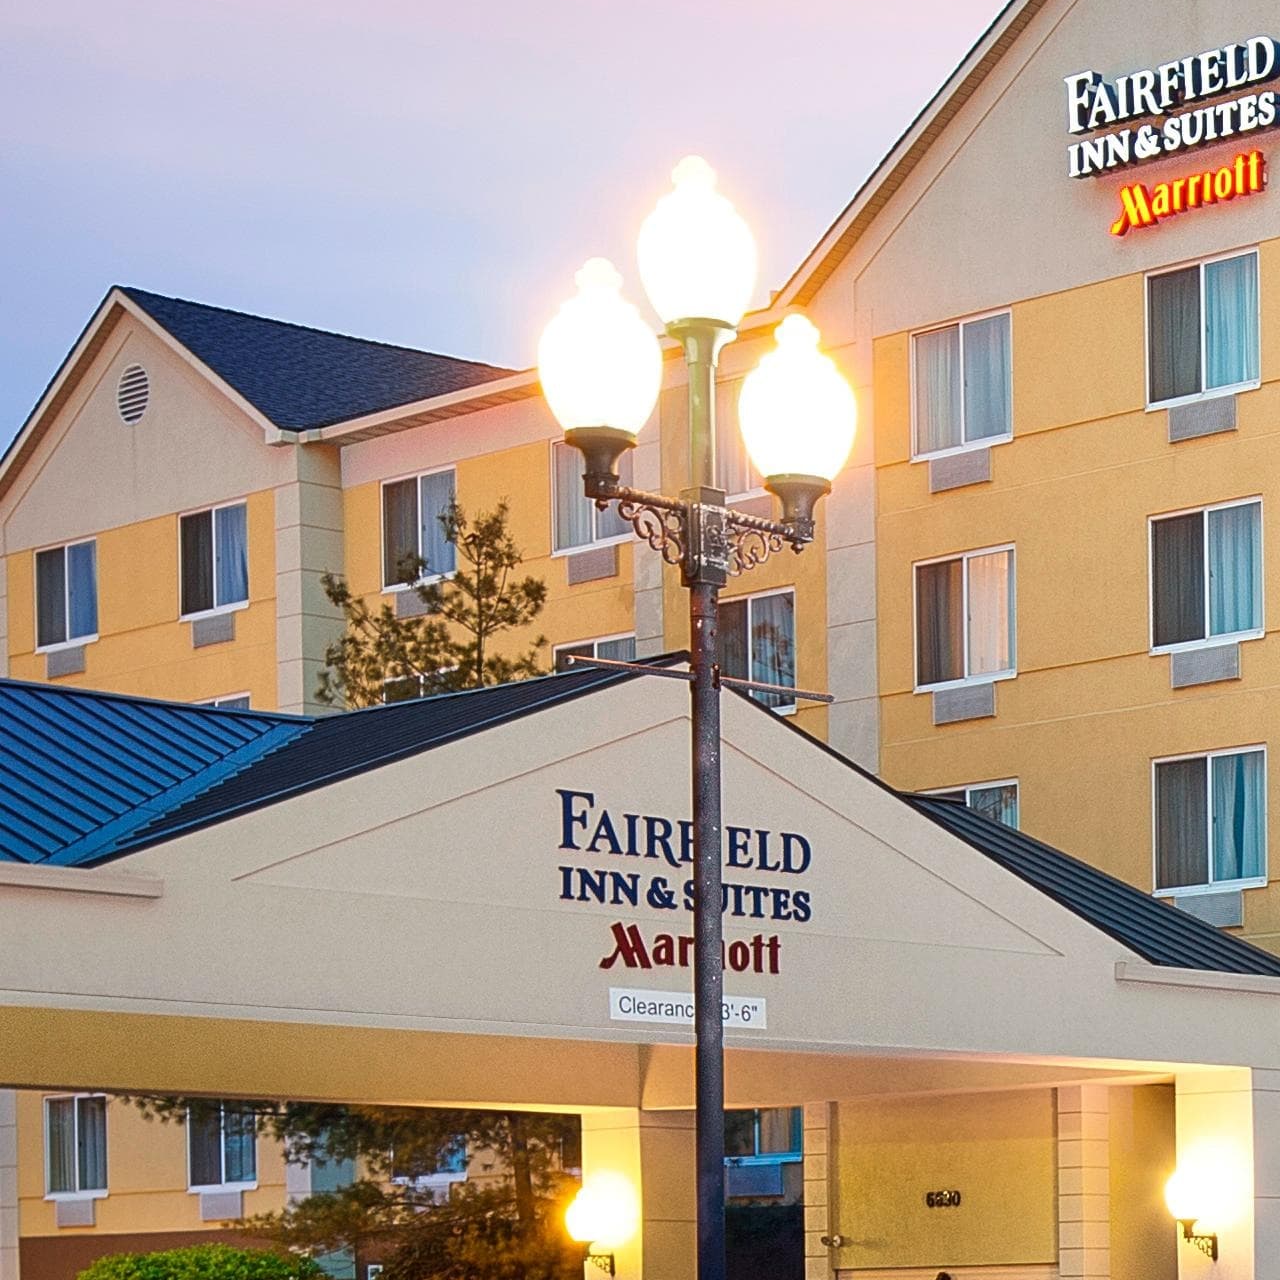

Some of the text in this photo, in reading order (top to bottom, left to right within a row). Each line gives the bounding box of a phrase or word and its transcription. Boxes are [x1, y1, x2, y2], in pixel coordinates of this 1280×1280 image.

[1063, 35, 1279, 134] FAIRFIELD
[1162, 91, 1278, 152] SUITES
[1110, 150, 1267, 236] Marriott
[555, 788, 812, 874] FAIRFELD
[558, 866, 640, 907] INN
[646, 876, 678, 910] &
[598, 921, 782, 974] Marott
[618, 995, 758, 1022] Clearanc 3'-6"
